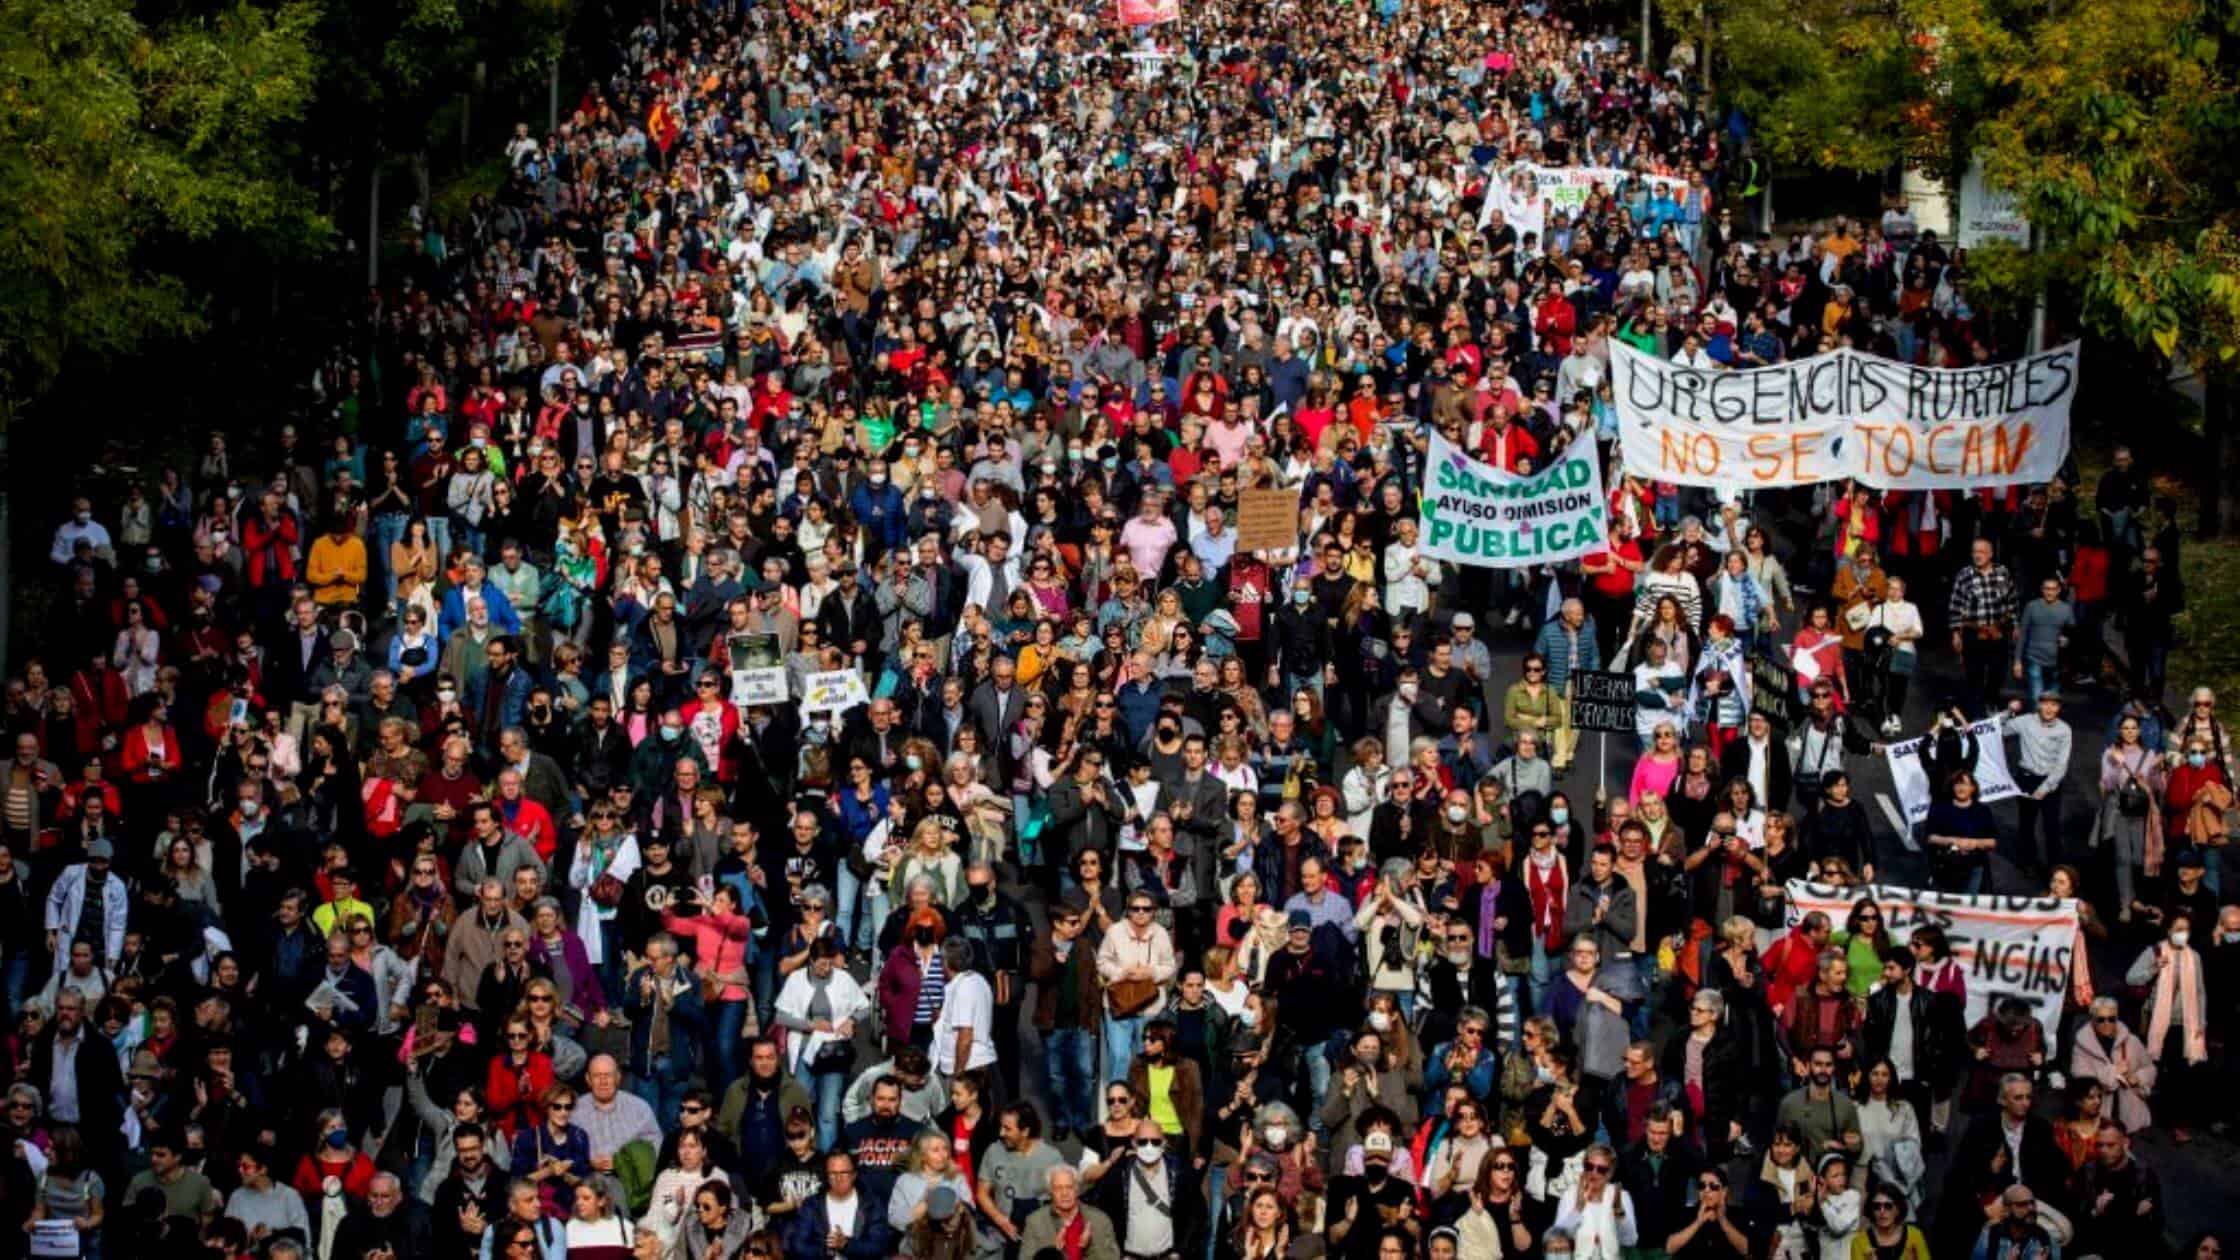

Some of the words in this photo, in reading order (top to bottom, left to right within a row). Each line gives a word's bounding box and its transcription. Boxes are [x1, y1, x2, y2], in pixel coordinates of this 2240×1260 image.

[1630, 354, 1887, 424] URGENCIAS
[1907, 352, 2073, 421] RURALES
[1661, 427, 1721, 476] NO
[1747, 432, 1824, 481] SE
[1855, 422, 2031, 477] TOCAN
[1437, 495, 1497, 520] AYUSO
[1429, 516, 1600, 557] PÚBLICA
